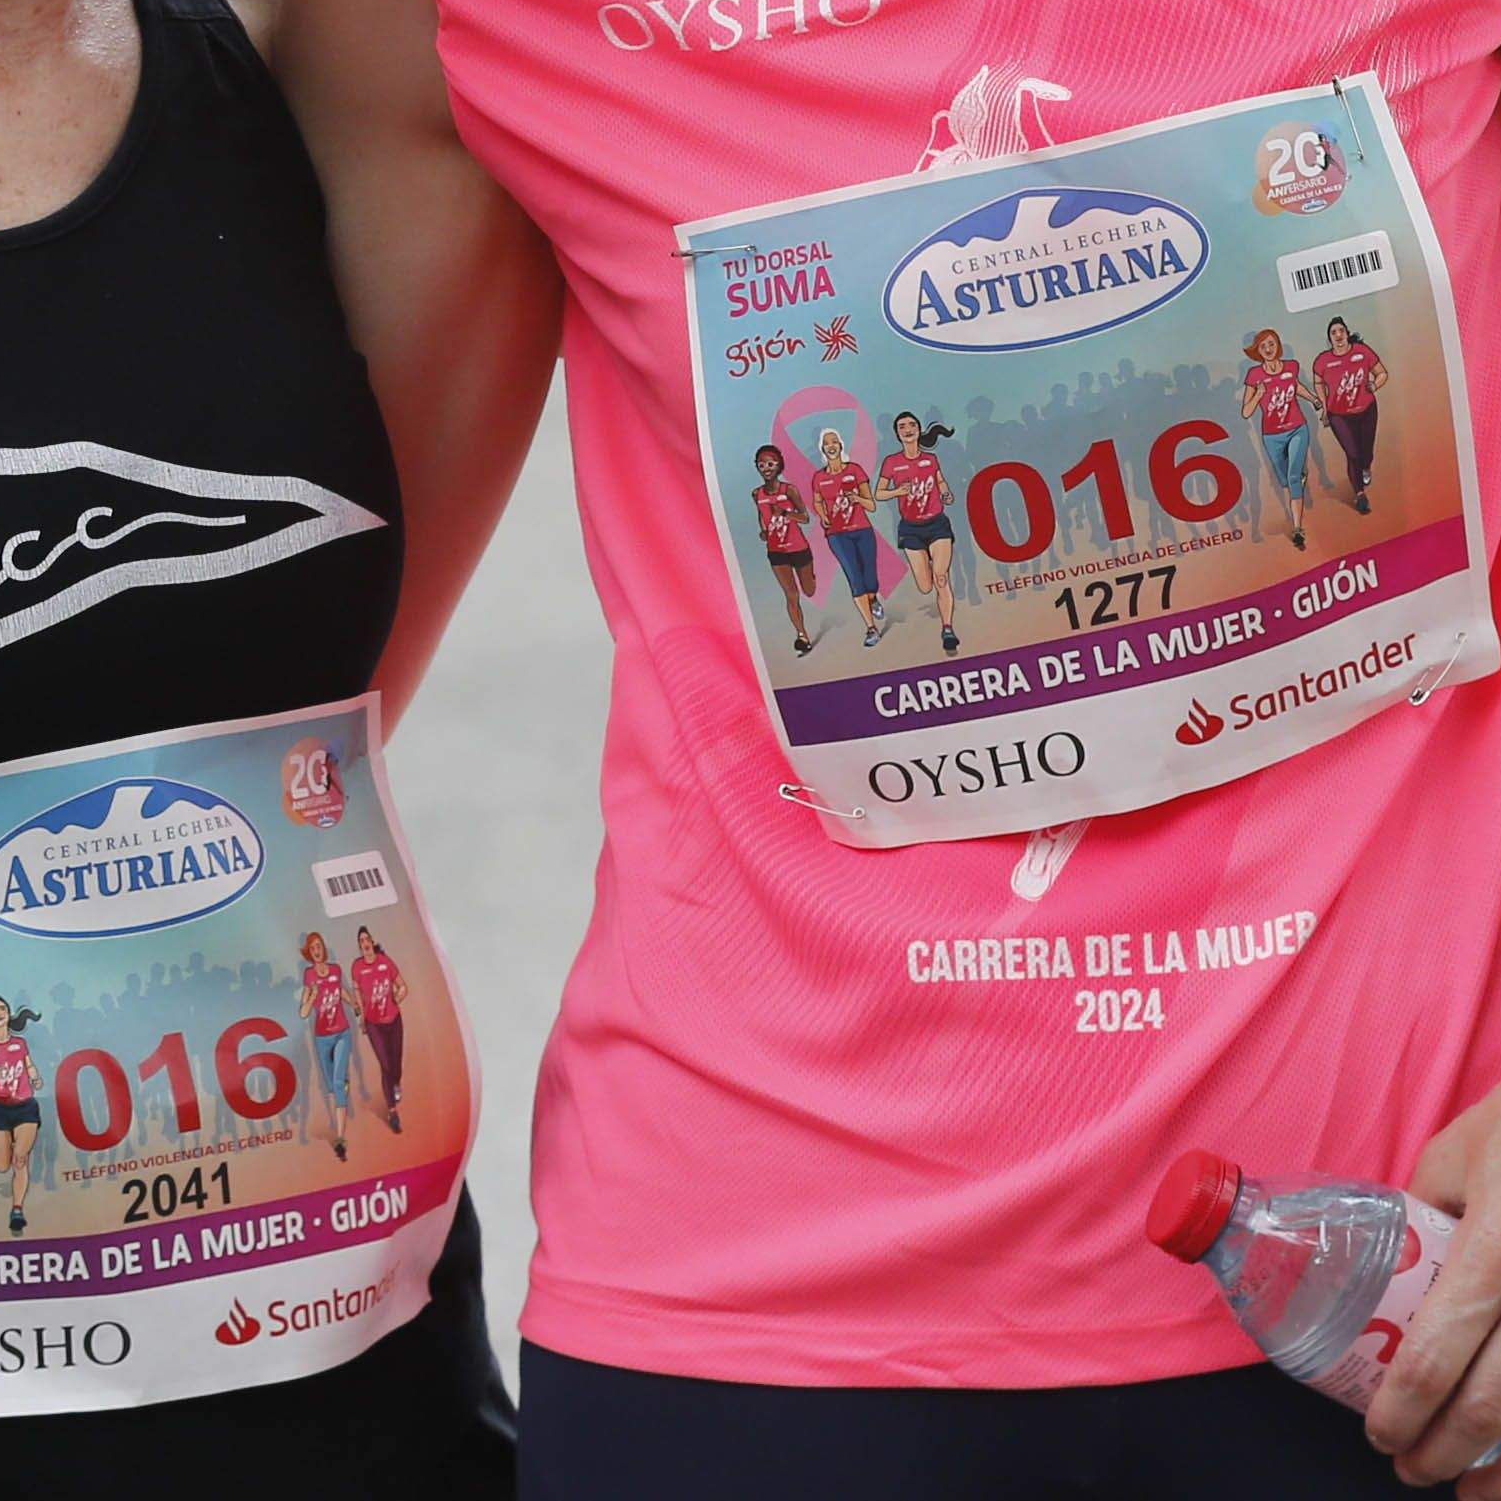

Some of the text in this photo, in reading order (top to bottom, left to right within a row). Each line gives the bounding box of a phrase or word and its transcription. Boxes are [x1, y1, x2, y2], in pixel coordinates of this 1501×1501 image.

[723, 240, 833, 281] TU DORSAL
[952, 216, 1168, 276] CENTRAL LECHERA
[729, 265, 836, 318] SUMA
[912, 238, 1189, 331] ASTURIANA
[725, 328, 806, 378] gijón
[965, 419, 1244, 564] 016
[985, 528, 1244, 595] TELÉFONO VIOLENCIA DE GÉNERO
[1054, 565, 1177, 631] 1277
[874, 558, 1379, 719] CARRERA DE LA MUJER GIJÓN
[1229, 632, 1417, 731] Santander
[867, 731, 1087, 804] OYSHO
[43, 815, 233, 862] CENTRAL LECHERA
[0, 834, 255, 915] ASTURIANA
[907, 910, 1318, 984] CARRERA DE LA MUJER
[1075, 987, 1166, 1034] 2024
[54, 1016, 298, 1152] 016
[62, 1159, 139, 1182] TELÉFONO
[141, 1146, 215, 1169] VIOLENCIA
[217, 1139, 234, 1154] DE
[121, 1161, 232, 1225] 2041
[102, 1242, 143, 1279] DE
[152, 1233, 191, 1270] LA
[201, 1210, 305, 1262] MUJER
[330, 1181, 408, 1233] GIJÓN
